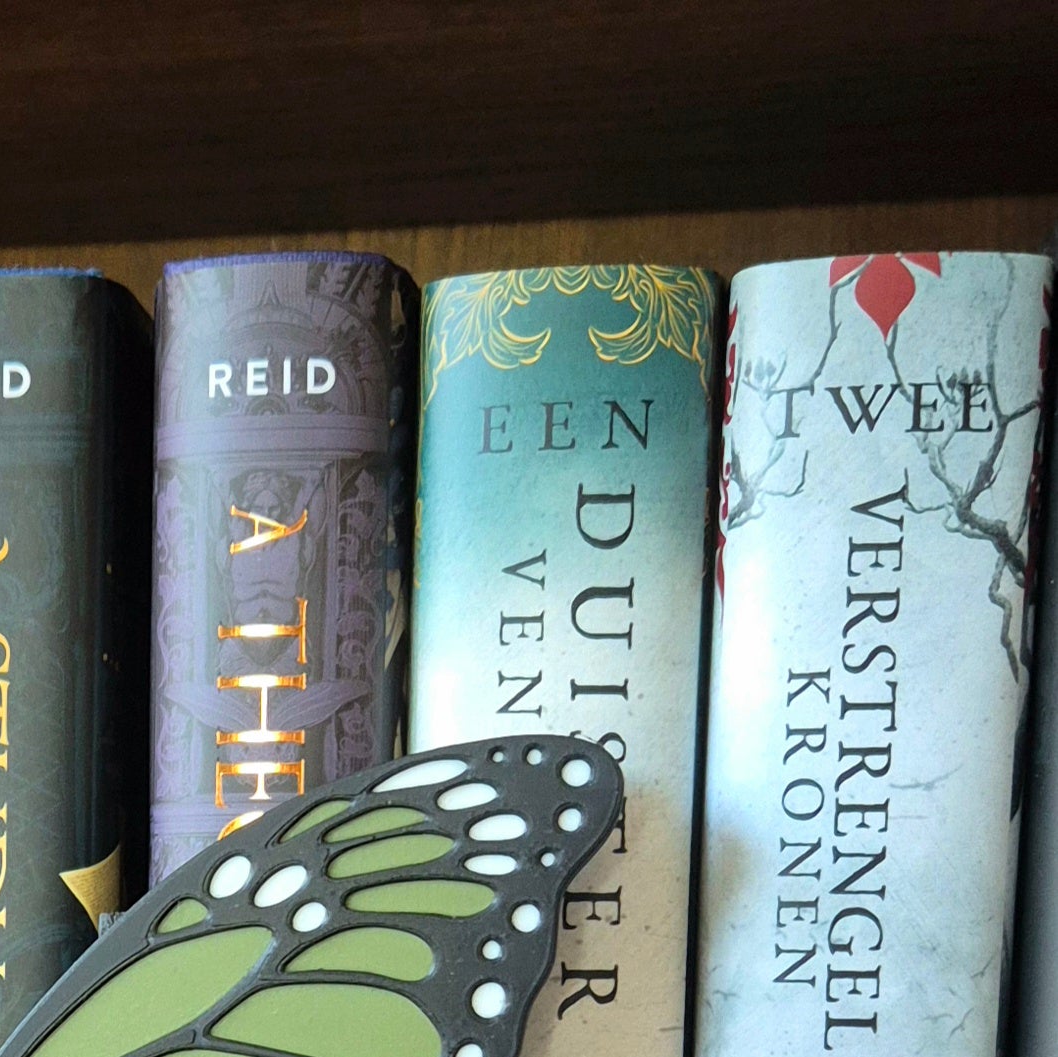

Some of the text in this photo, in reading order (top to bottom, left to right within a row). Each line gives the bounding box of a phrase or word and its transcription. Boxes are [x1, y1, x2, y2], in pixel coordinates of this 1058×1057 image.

[208, 357, 337, 399] REID
[478, 398, 654, 456] EEN
[777, 380, 995, 440] TWEE
[230, 504, 308, 555] A
[771, 667, 832, 988] KRONEN
